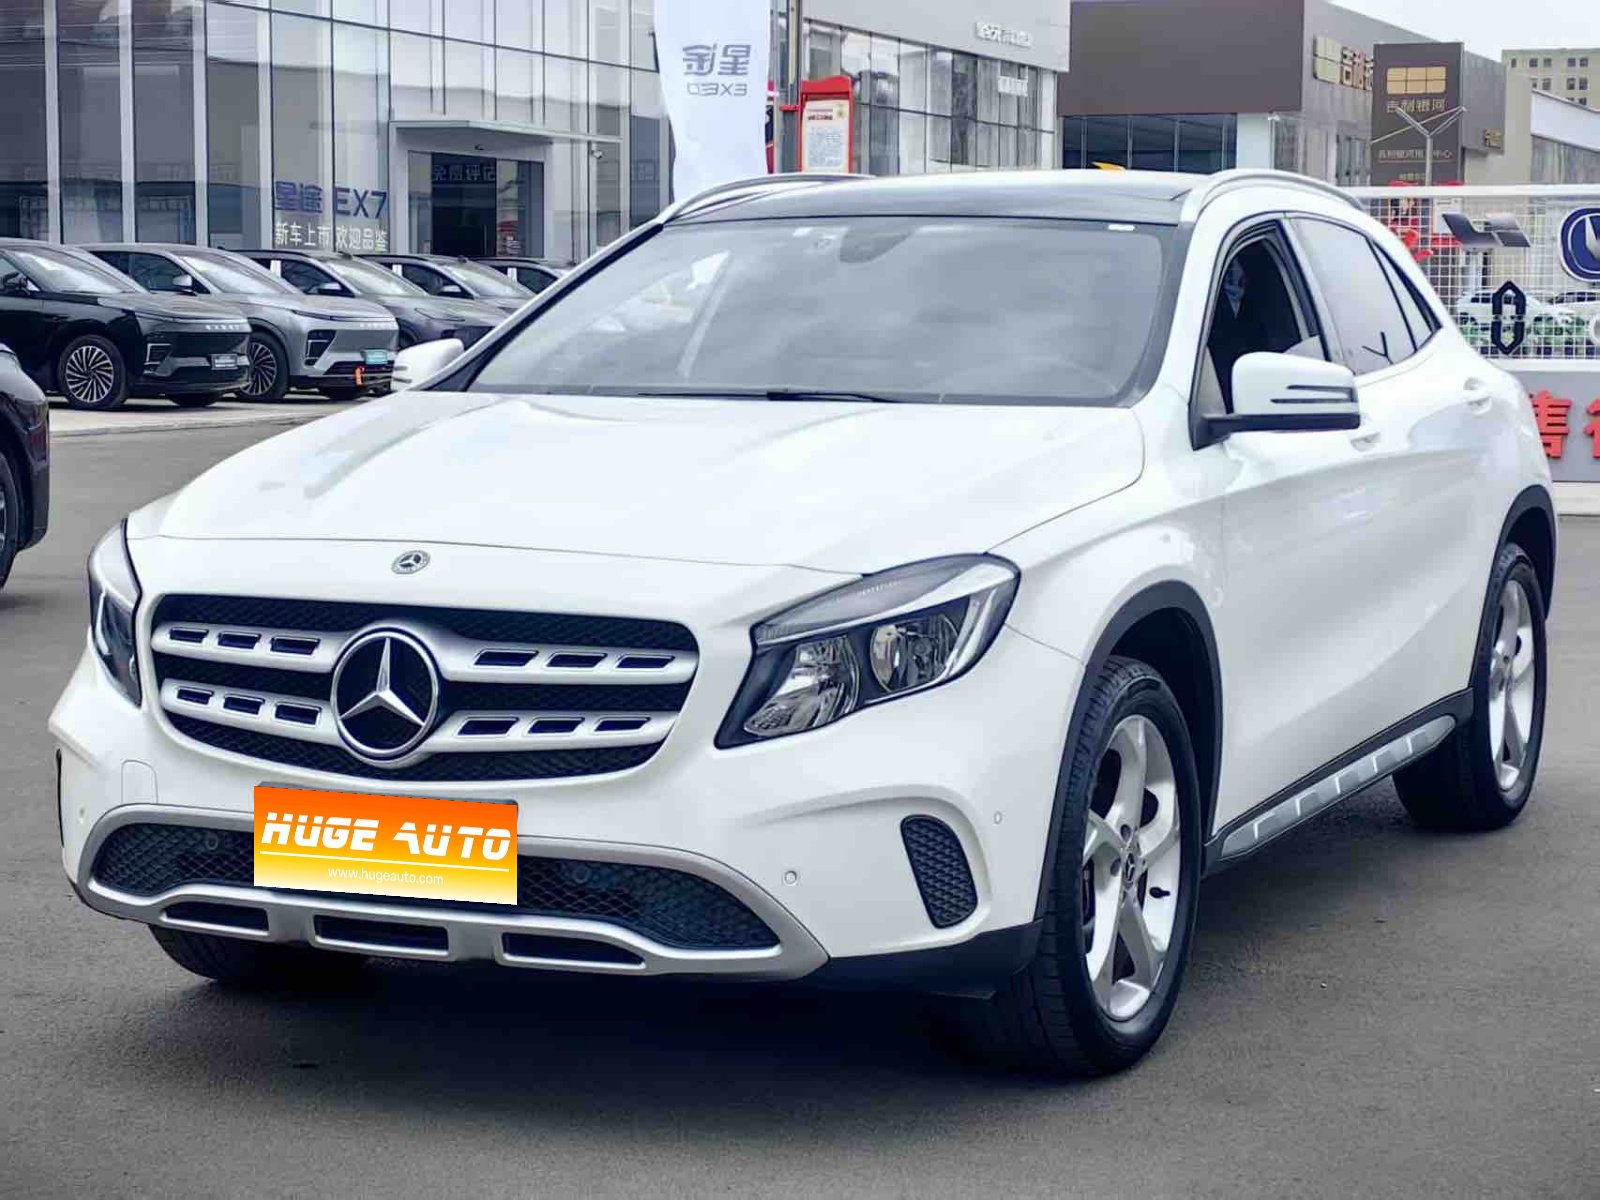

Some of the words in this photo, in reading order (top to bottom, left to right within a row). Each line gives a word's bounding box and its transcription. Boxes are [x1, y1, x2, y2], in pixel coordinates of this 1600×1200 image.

[333, 187, 387, 219] EX7
[275, 221, 331, 248] 新车上市
